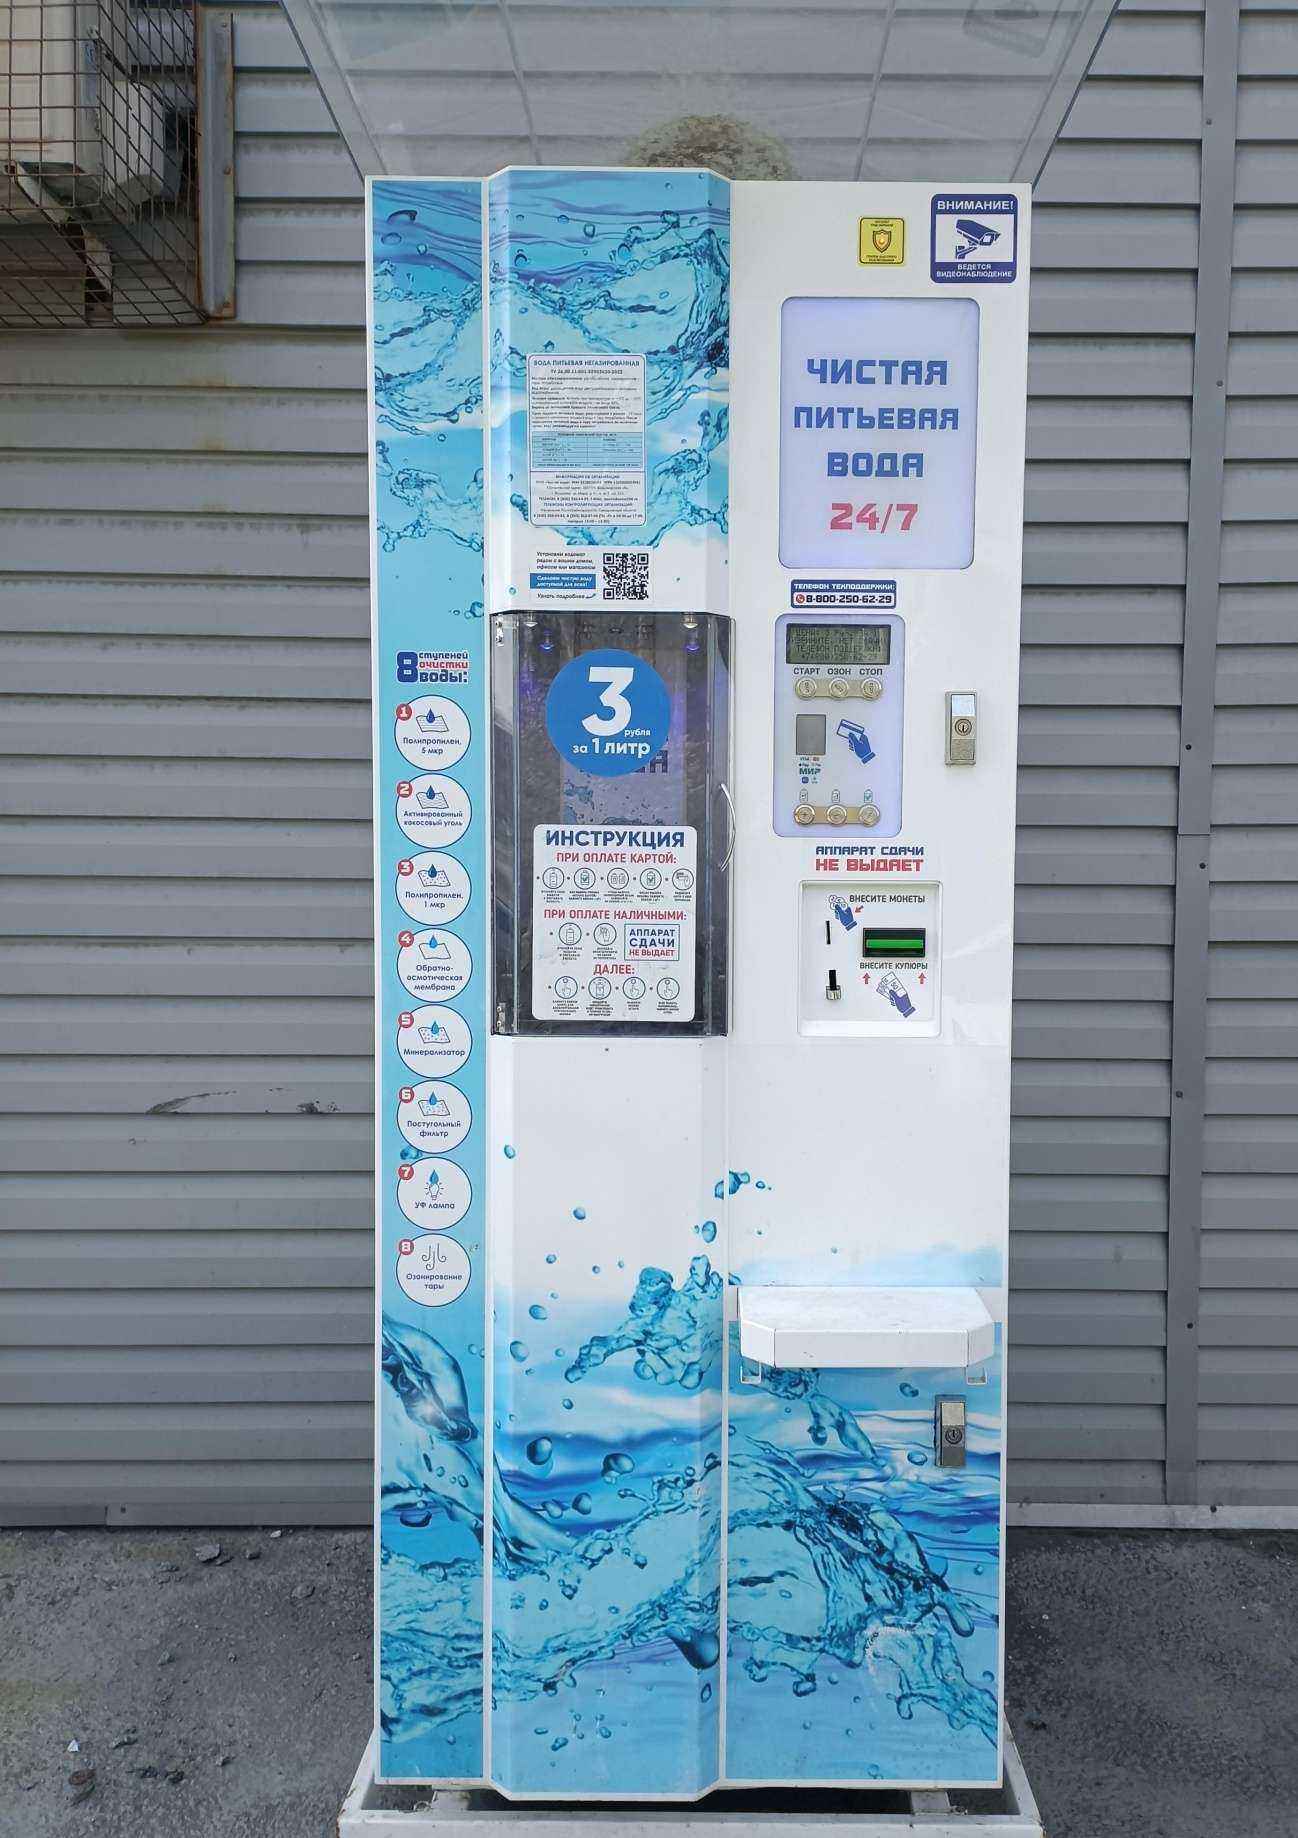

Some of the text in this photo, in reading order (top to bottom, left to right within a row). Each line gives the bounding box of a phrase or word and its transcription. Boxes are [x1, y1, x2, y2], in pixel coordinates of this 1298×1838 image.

[937, 200, 1014, 210] ВНИМАНИЕ!
[957, 263, 992, 271] ВЕДЕТСЯ
[807, 358, 948, 386] ЧИСТАЯ
[794, 406, 959, 430] ПИТЬЕВАЯ
[827, 452, 924, 478] ВОДА
[830, 503, 918, 535] 24/7
[806, 595, 892, 604] 8-800-250-62-29
[397, 651, 468, 682] 8 ступеней
[419, 661, 468, 669] очистки
[419, 669, 468, 682] воды:
[581, 666, 651, 738] 3 рубля
[403, 737, 462, 746] Полипропилен,
[572, 738, 651, 759] за 1 литр
[546, 830, 685, 850] ИНСТРУКЦИЯ
[815, 846, 924, 856] АППАРАТ СДАЧИ
[556, 851, 677, 864] ПРИ ОПЛАТЕ КАРТОЙ:
[815, 859, 924, 872] НЕ ВЫДАЕТ
[405, 891, 464, 900] Полипропилен,
[849, 895, 925, 903] ВНЕСИТЕ МОНЕТЫ
[544, 909, 687, 921] ПРИ ОПЛАТЕ НАЛИЧНЫМИ:
[629, 929, 676, 937] АППАРАТ
[629, 938, 675, 948] СДАЧИ
[642, 949, 676, 957] ВЫДАЕТ
[415, 964, 454, 972] Обратно-
[593, 964, 635, 975] ДАЛЕЕ:
[859, 962, 928, 970] ВНЕСИТЕ КУПЮРЫ
[403, 1048, 466, 1057] Минерализатор
[407, 1120, 462, 1128] Постугольный
[419, 1130, 449, 1138] фильтр
[406, 1273, 463, 1281] Озонирование
